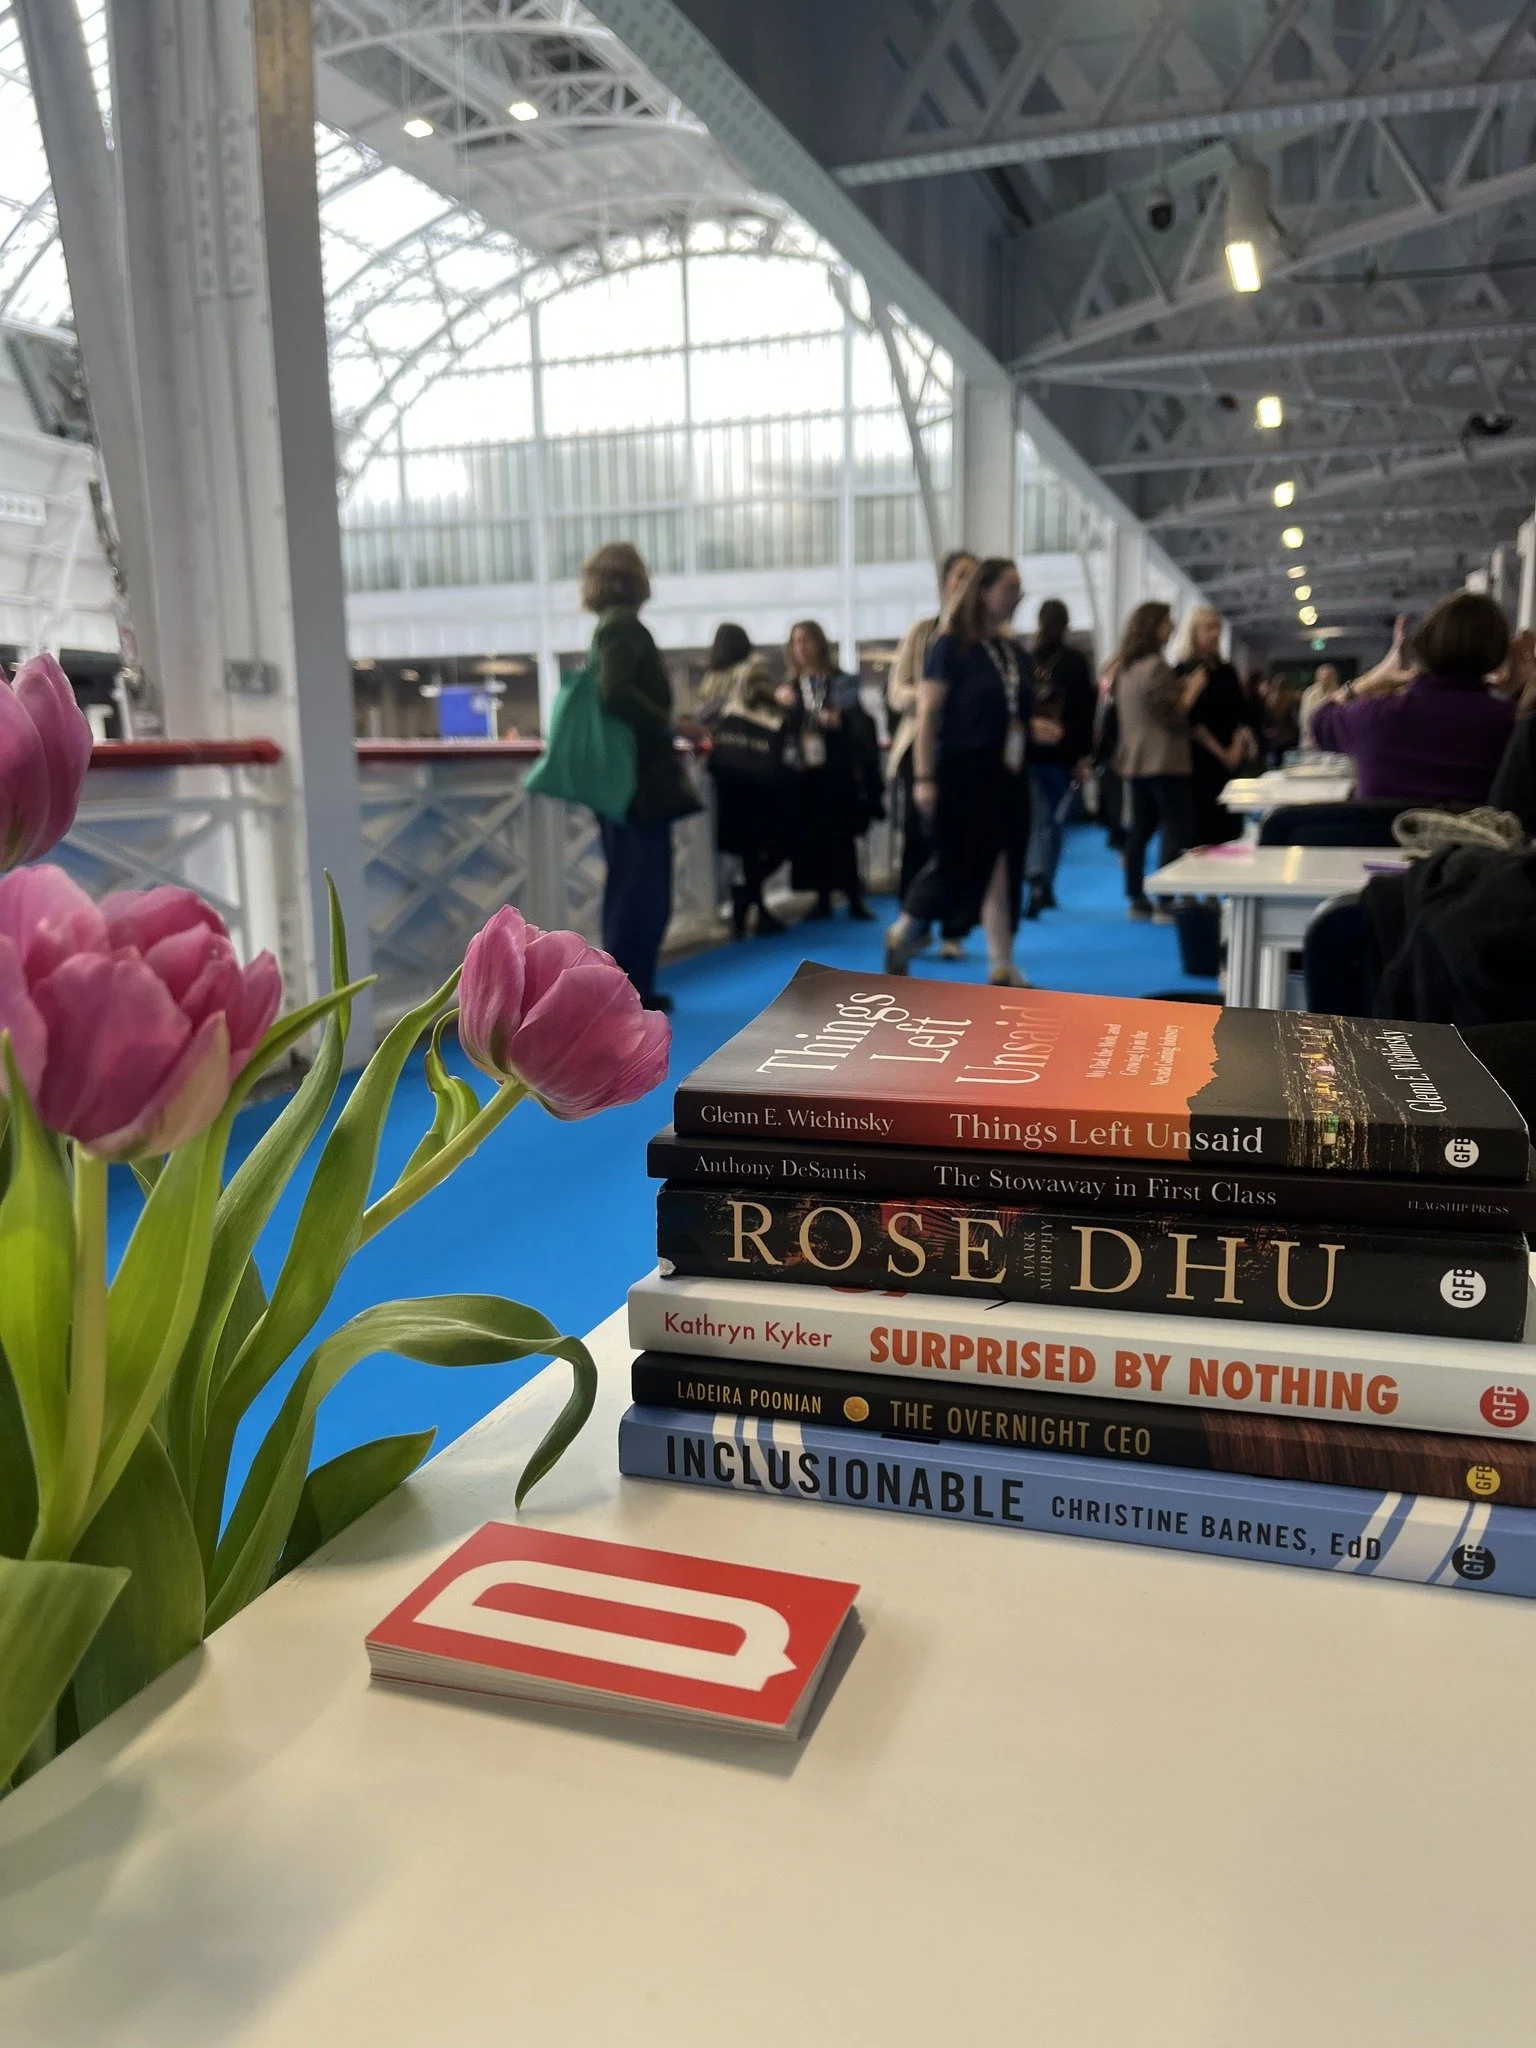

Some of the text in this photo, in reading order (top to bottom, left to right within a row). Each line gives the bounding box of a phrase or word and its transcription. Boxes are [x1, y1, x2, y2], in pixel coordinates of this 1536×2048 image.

[756, 993, 910, 1074] Things
[869, 1016, 973, 1064] Left
[955, 1004, 1067, 1085] Unsaid
[1094, 1049, 1114, 1057] the
[1374, 1028, 1447, 1113] Glenn E. Wichinsky
[700, 1104, 895, 1137] Glenn E. Wichinsky
[949, 1113, 1264, 1154] Things Left Unsaid
[694, 1154, 867, 1182] Anthony DeSantis
[1453, 1138, 1472, 1163] GFB
[933, 1165, 1278, 1206] The Stowaway in First Class
[1407, 1200, 1510, 1214] FLAGSHIP PRESS
[727, 1200, 1008, 1286] ROSE
[1023, 1231, 1036, 1279] MARK
[1040, 1220, 1053, 1291] MURPHY
[1069, 1225, 1346, 1312] DHU
[1451, 1267, 1476, 1302] GFB
[664, 1311, 833, 1350] Kathryn Kyker
[869, 1326, 1400, 1416] SURPRISED BY NOTHING
[677, 1379, 822, 1415] LADEIRA POONIAN
[1490, 1383, 1518, 1423] GFB
[889, 1399, 1153, 1457] THE OVERNIGHT CEO
[666, 1434, 1026, 1524] INCLUSIONABLE
[1474, 1464, 1494, 1491] GFB
[1051, 1495, 1382, 1562] CHRISTINE BARNES, EdD
[1461, 1543, 1487, 1576] GFB
